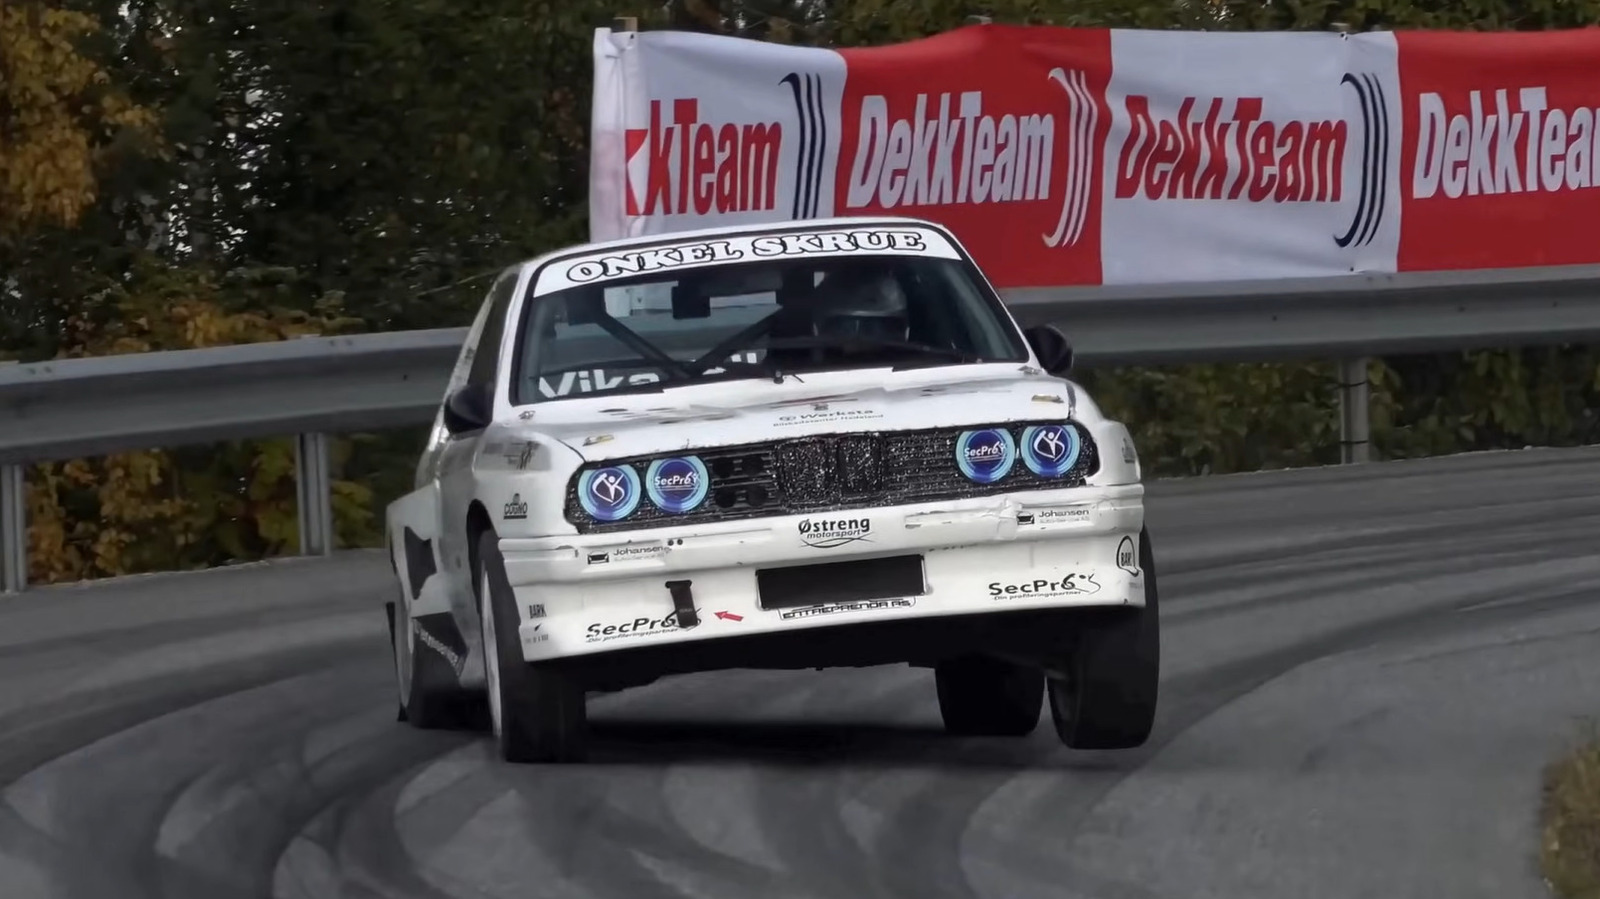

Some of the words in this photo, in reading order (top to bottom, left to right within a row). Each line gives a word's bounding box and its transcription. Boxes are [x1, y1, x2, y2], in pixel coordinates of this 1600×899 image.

[846, 90, 1054, 208] DekkTeam
[1115, 95, 1347, 202] DekkTeam
[566, 241, 744, 282] ONKEL
[751, 231, 926, 256] SKRUE
[1039, 509, 1090, 518] Johansen
[798, 518, 870, 535] Østreng
[806, 529, 861, 539] motorsport
[613, 545, 664, 556] Johansen
